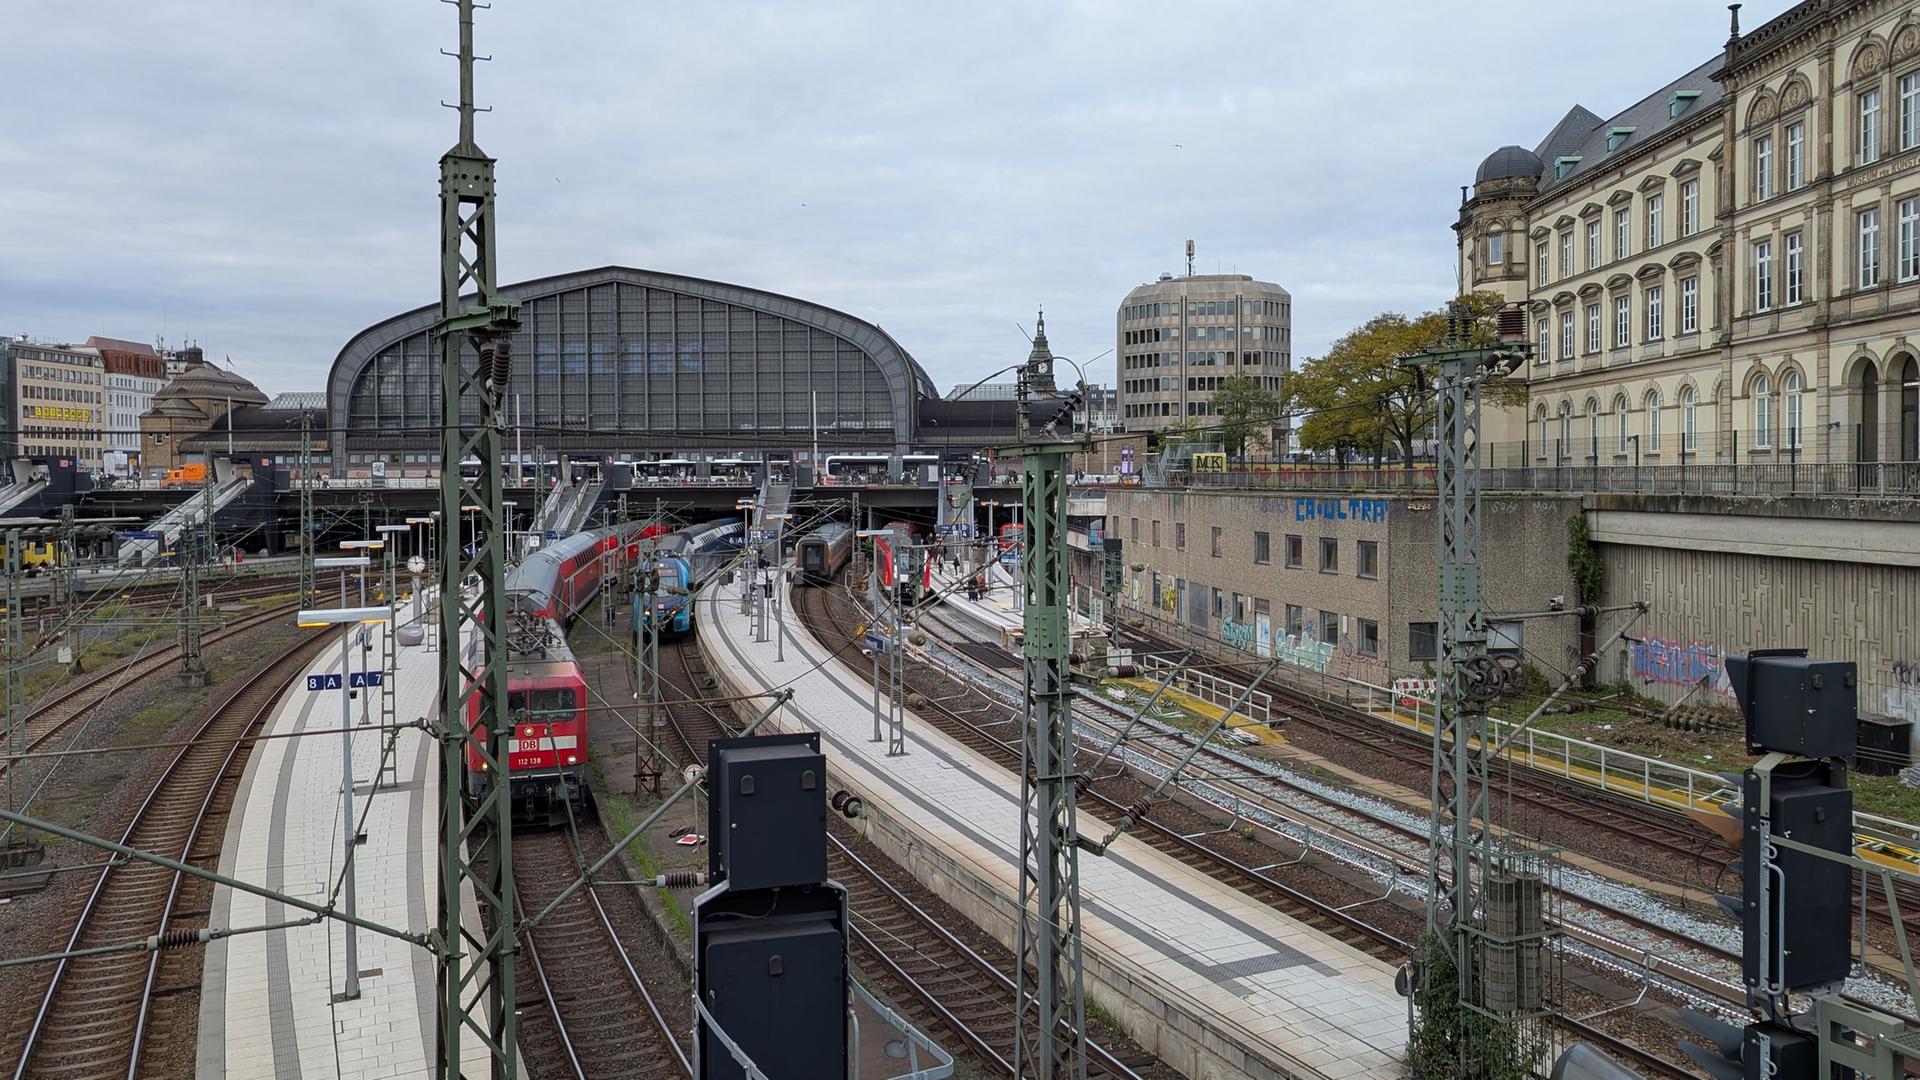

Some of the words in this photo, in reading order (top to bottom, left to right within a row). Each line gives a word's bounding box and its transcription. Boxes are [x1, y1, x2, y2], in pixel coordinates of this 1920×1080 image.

[1847, 169, 1878, 188] MUSEUM
[1892, 156, 1918, 173] KUNST
[309, 678, 317, 689] 8
[327, 677, 336, 688] A
[356, 675, 365, 686] A
[375, 674, 382, 685] 7
[522, 740, 536, 750] DB
[518, 758, 528, 766] 112
[530, 757, 541, 765] 138
